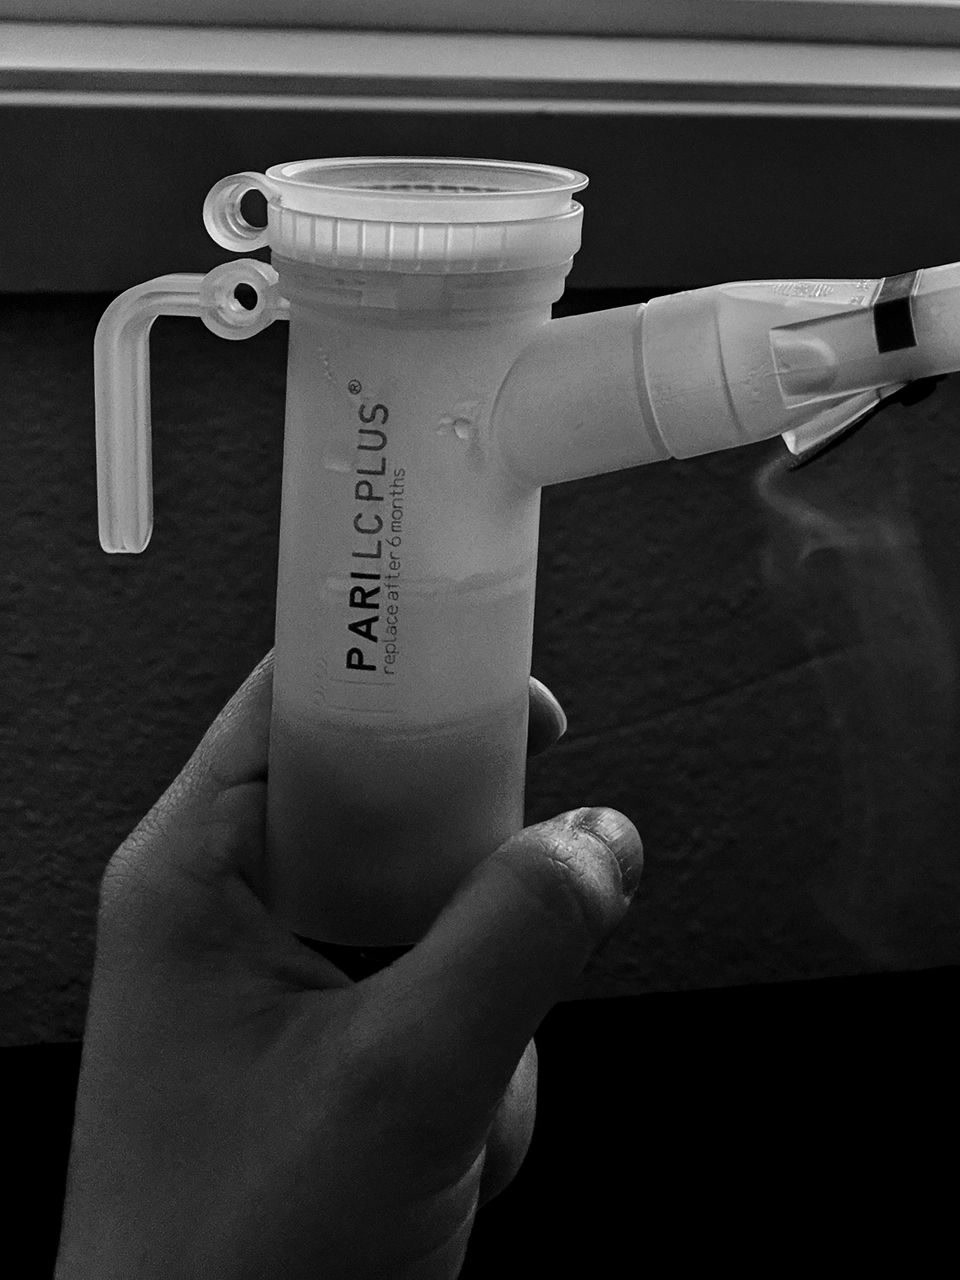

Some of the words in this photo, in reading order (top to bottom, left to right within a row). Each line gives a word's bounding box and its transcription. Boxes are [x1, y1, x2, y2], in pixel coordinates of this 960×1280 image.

[389, 467, 405, 533] months
[352, 512, 383, 558] LC
[385, 536, 401, 547] 6
[384, 552, 401, 601] after
[346, 572, 380, 671] PARI
[383, 604, 399, 675] replace
